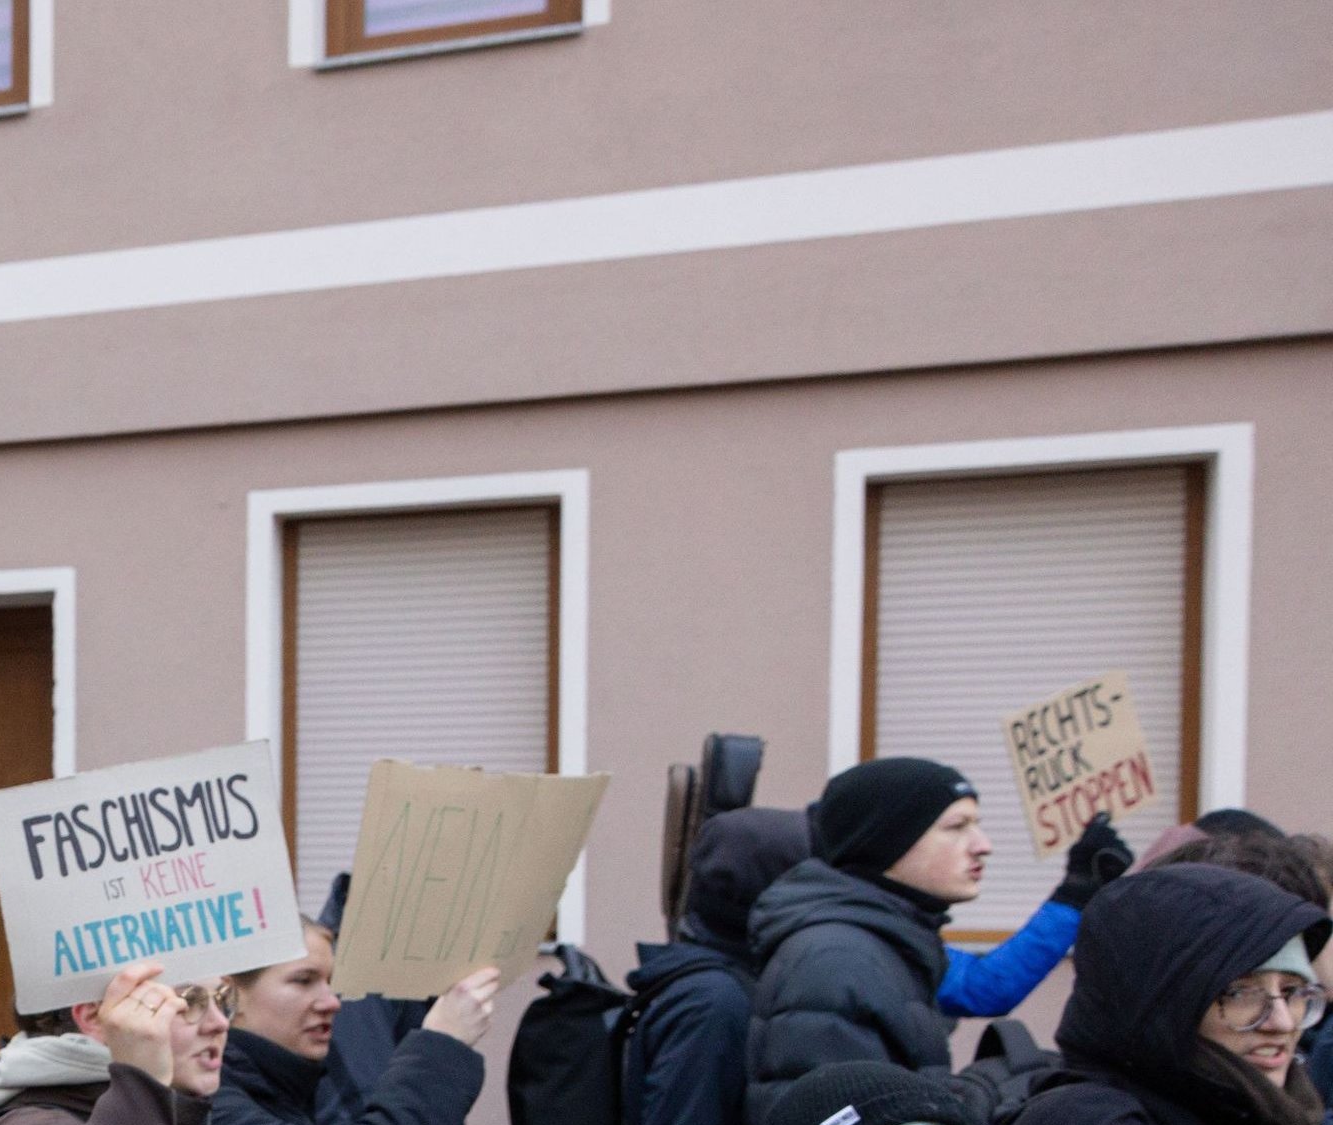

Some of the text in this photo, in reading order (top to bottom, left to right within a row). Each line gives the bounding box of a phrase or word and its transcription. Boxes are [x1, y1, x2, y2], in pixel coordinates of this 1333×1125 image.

[1011, 683, 1122, 766] RECHTS-
[1025, 743, 1093, 795] RUCK
[1036, 751, 1155, 847] STOPPEN
[22, 773, 259, 880] FASCHISMUS
[102, 852, 216, 900] IST KEINE
[53, 888, 269, 977] ALTERNATIVE!
